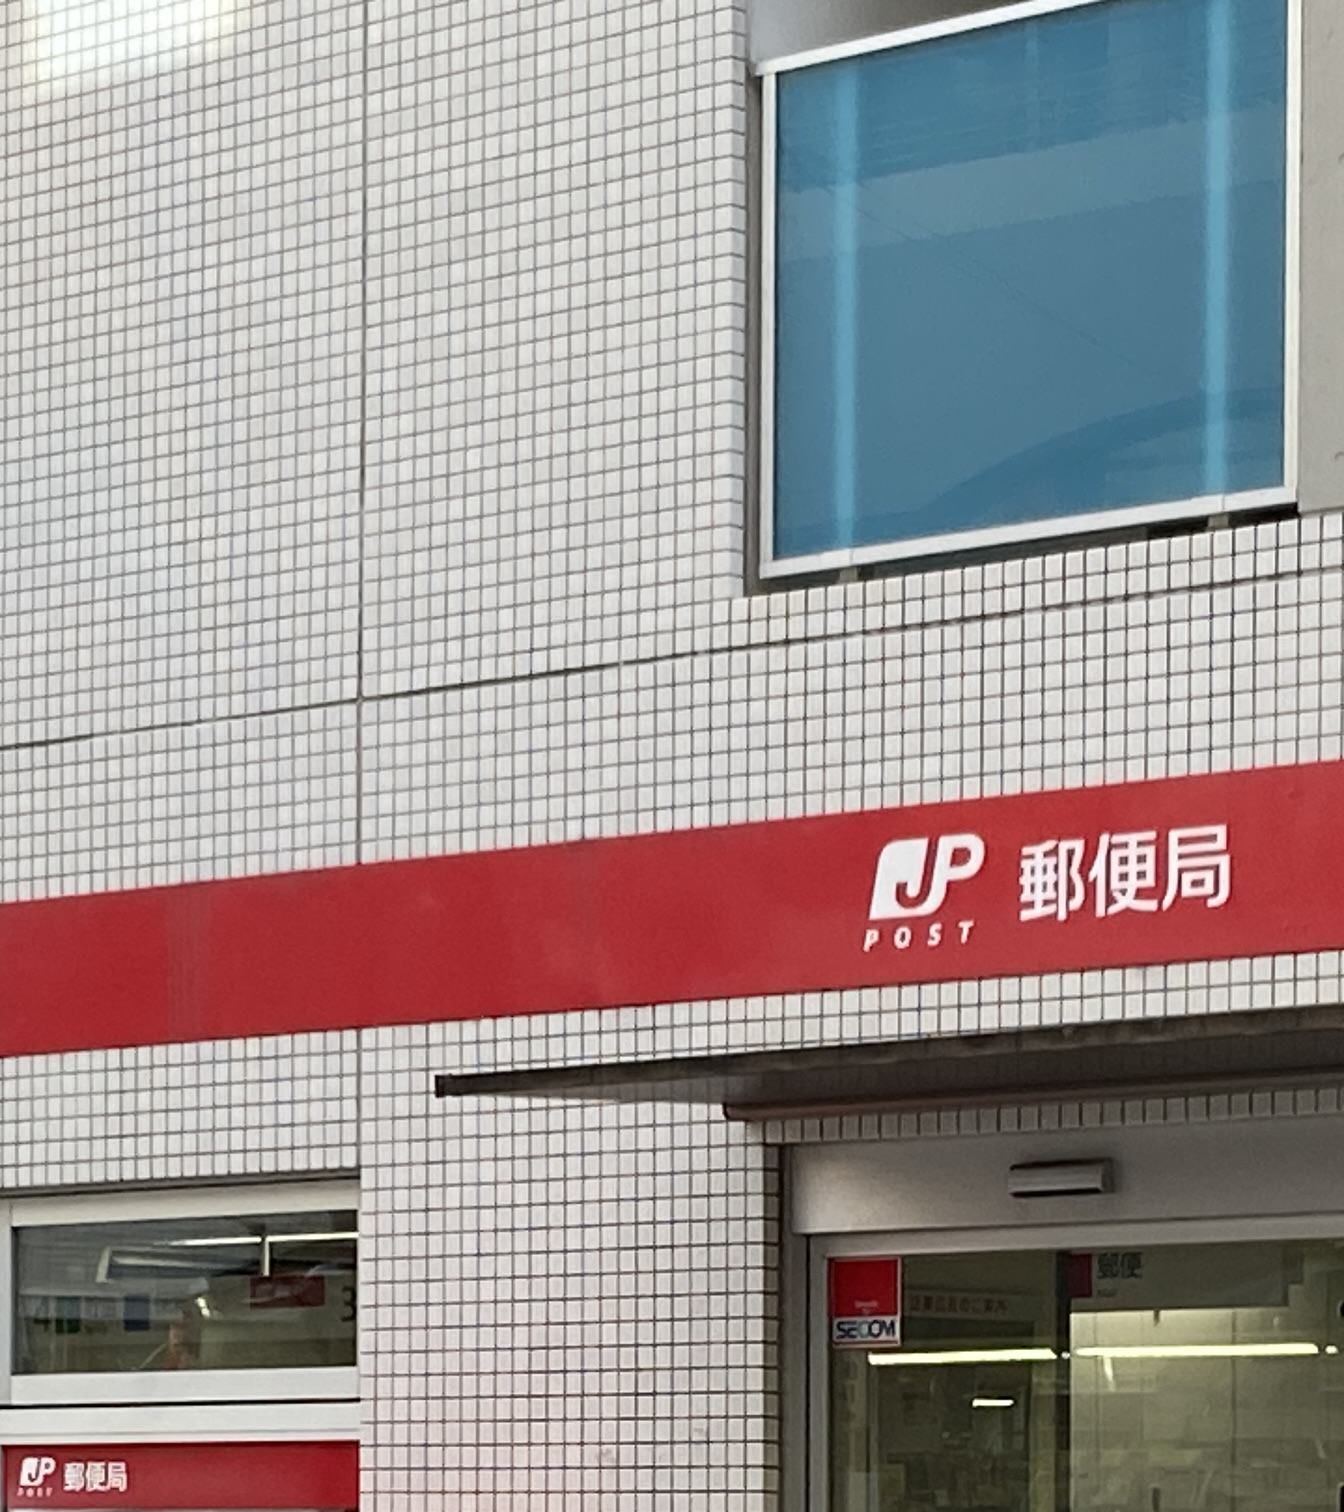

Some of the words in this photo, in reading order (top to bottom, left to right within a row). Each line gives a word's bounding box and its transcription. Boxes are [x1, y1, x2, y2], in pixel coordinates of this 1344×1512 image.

[1018, 823, 1232, 922] 郵便局
[863, 920, 976, 952] POST
[835, 1316, 899, 1341] SECOM
[63, 1461, 128, 1492] 郵便局
